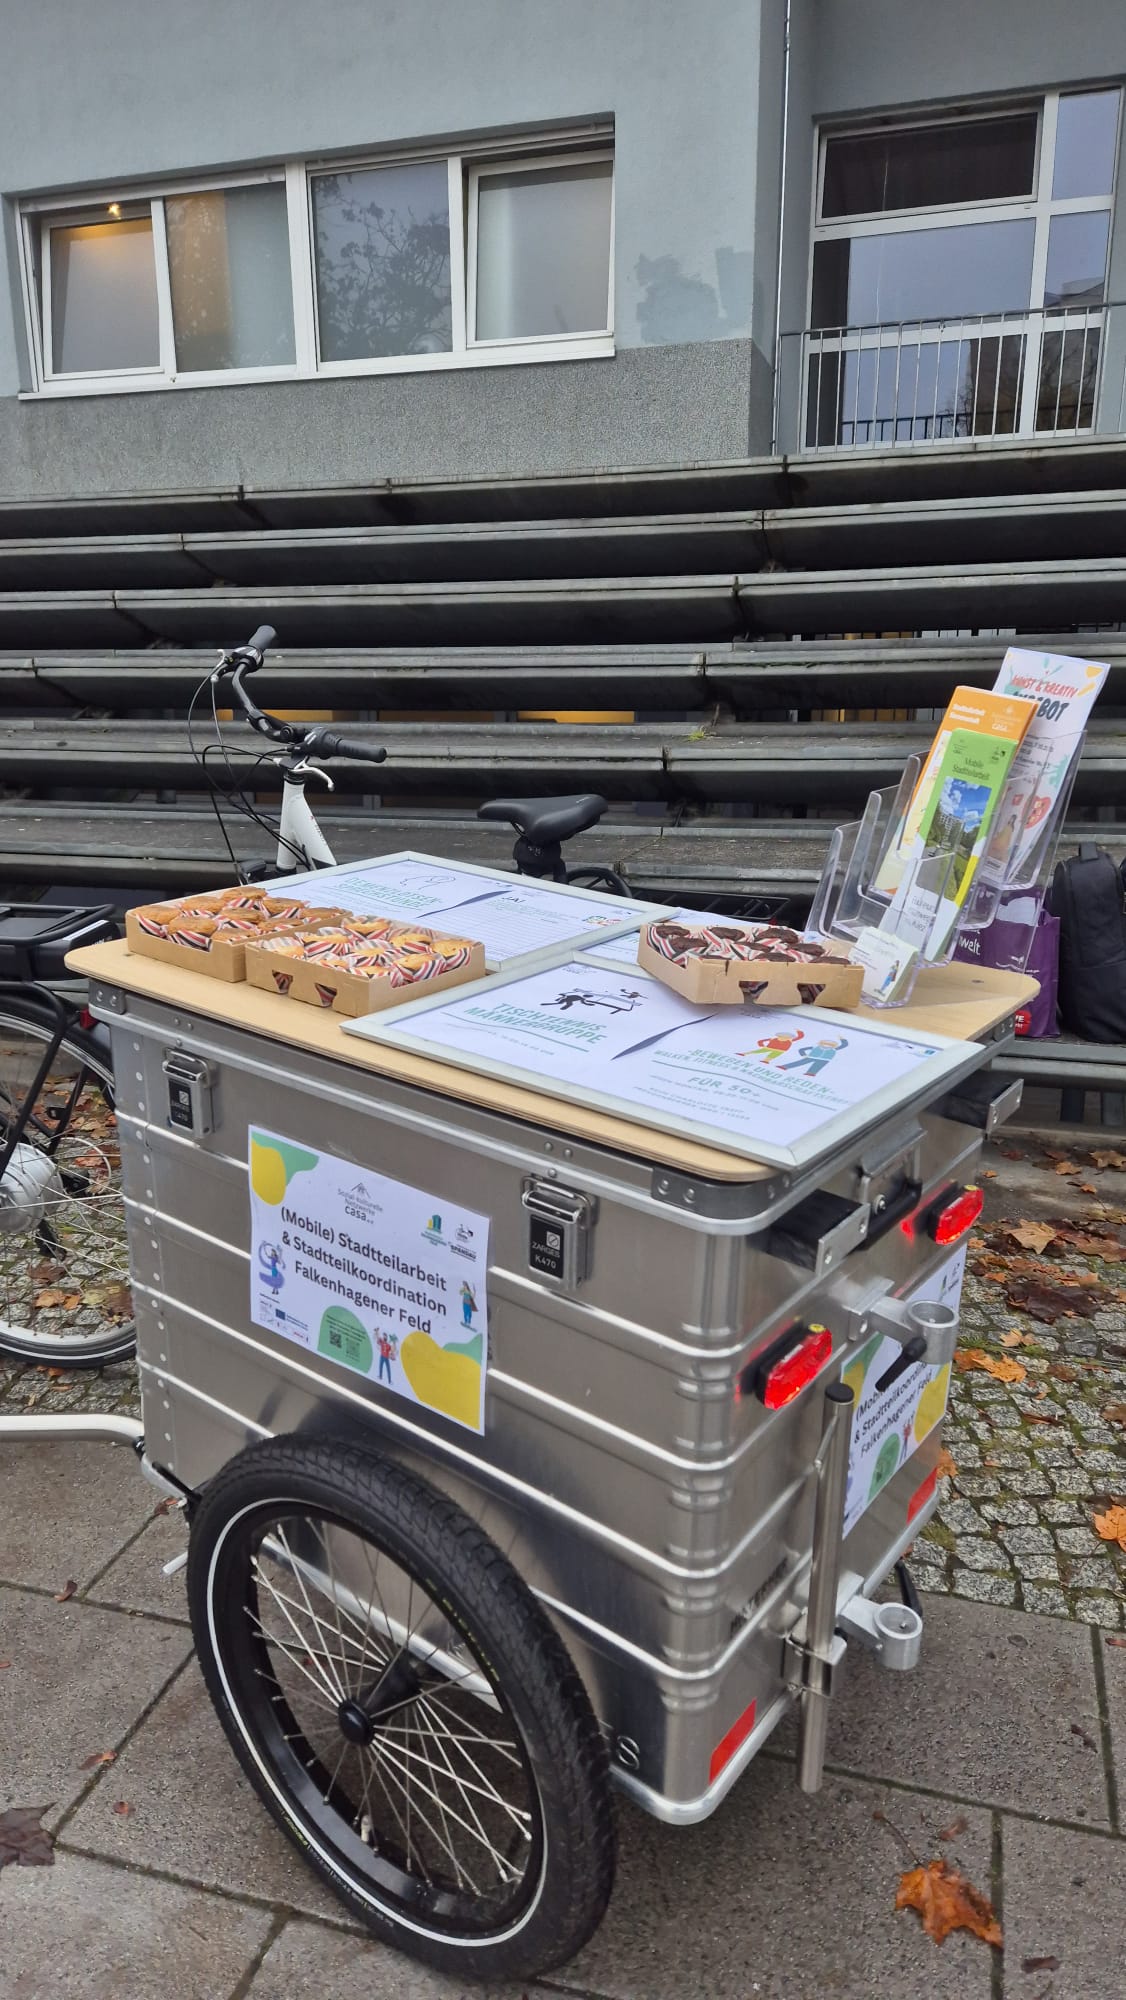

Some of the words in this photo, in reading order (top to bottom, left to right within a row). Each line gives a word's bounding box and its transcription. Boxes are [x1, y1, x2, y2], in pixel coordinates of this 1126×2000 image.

[464, 1007, 608, 1045] MÄNNERGRUPPE
[494, 1002, 608, 1031] TISCHTENNIS
[688, 1075, 722, 1090] FÜR
[753, 1066, 782, 1080] UND
[345, 1206, 367, 1221] casa
[281, 1206, 336, 1244] (Mobile)
[338, 1232, 448, 1293] Stadtteilarbeit
[531, 1241, 561, 1258] ZARGES
[282, 1230, 292, 1247] &
[293, 1236, 448, 1316] Stadtteilkoordination
[535, 1254, 557, 1269] K470
[295, 1261, 396, 1318] Falkenhagener
[399, 1307, 432, 1335] Feld
